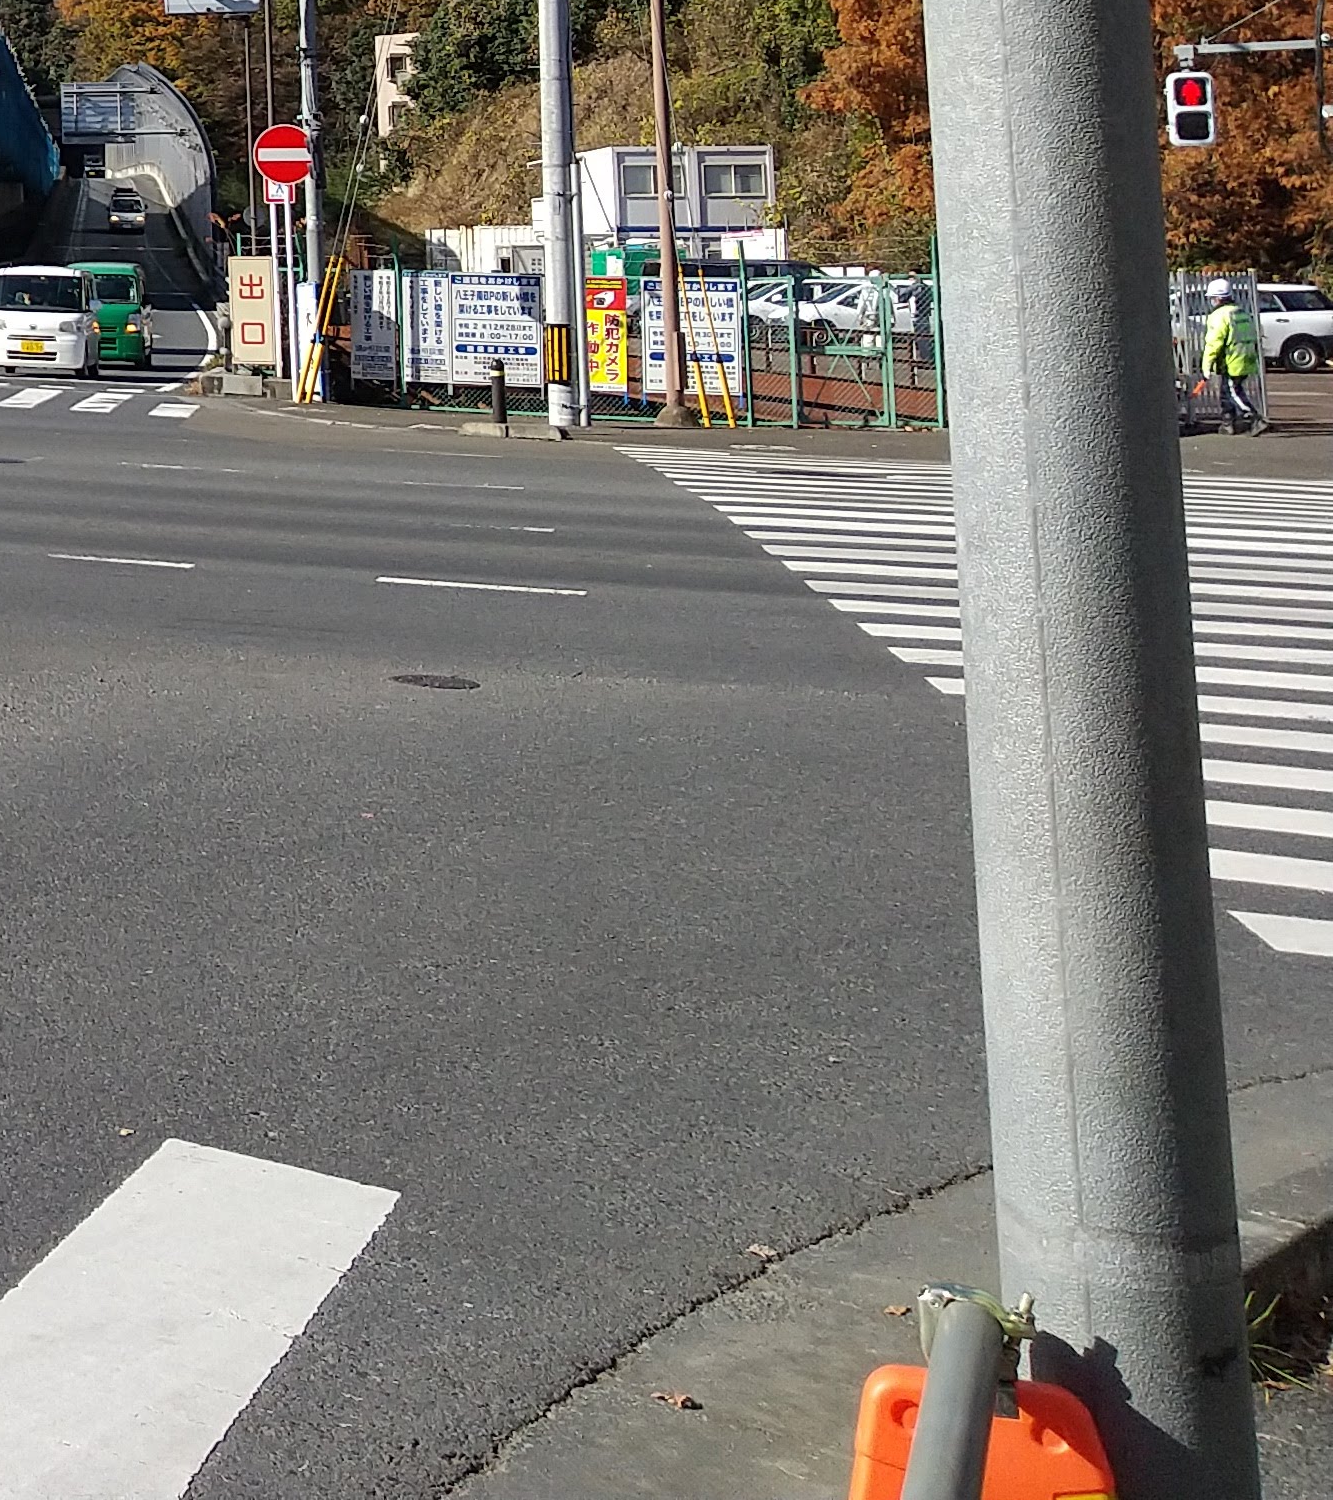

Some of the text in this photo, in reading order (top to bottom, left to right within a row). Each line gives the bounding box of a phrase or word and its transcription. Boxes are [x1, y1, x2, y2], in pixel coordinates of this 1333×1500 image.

[239, 274, 265, 344] 出口
[604, 313, 620, 382] 防犯カメラ
